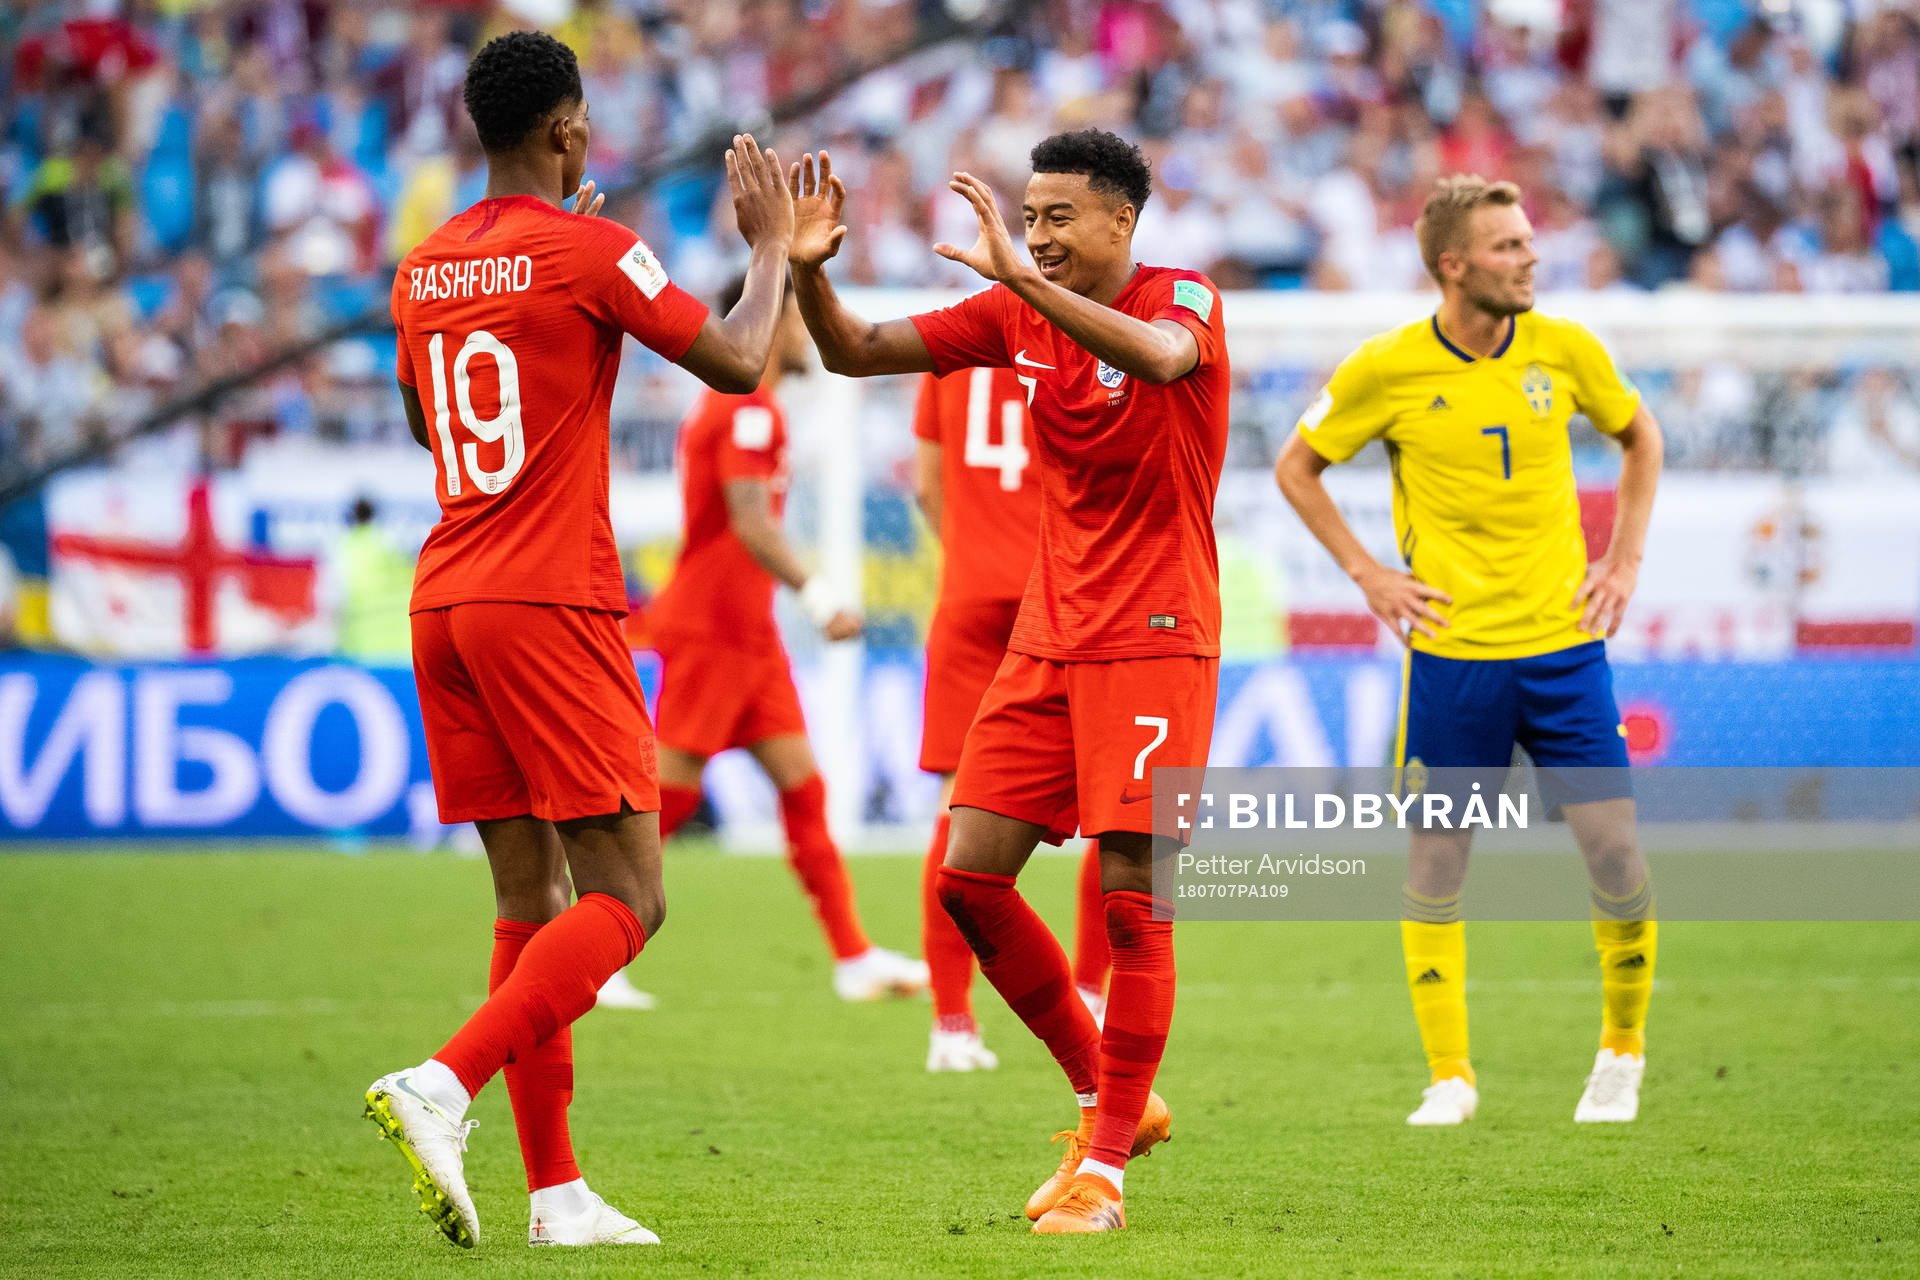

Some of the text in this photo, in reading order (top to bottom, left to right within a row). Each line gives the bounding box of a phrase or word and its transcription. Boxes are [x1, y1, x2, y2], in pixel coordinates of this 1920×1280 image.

[409, 255, 532, 300] RASHFORD
[428, 330, 525, 496] 19
[965, 367, 1029, 492] 4
[1481, 425, 1511, 480] 7
[1133, 715, 1169, 780] 7
